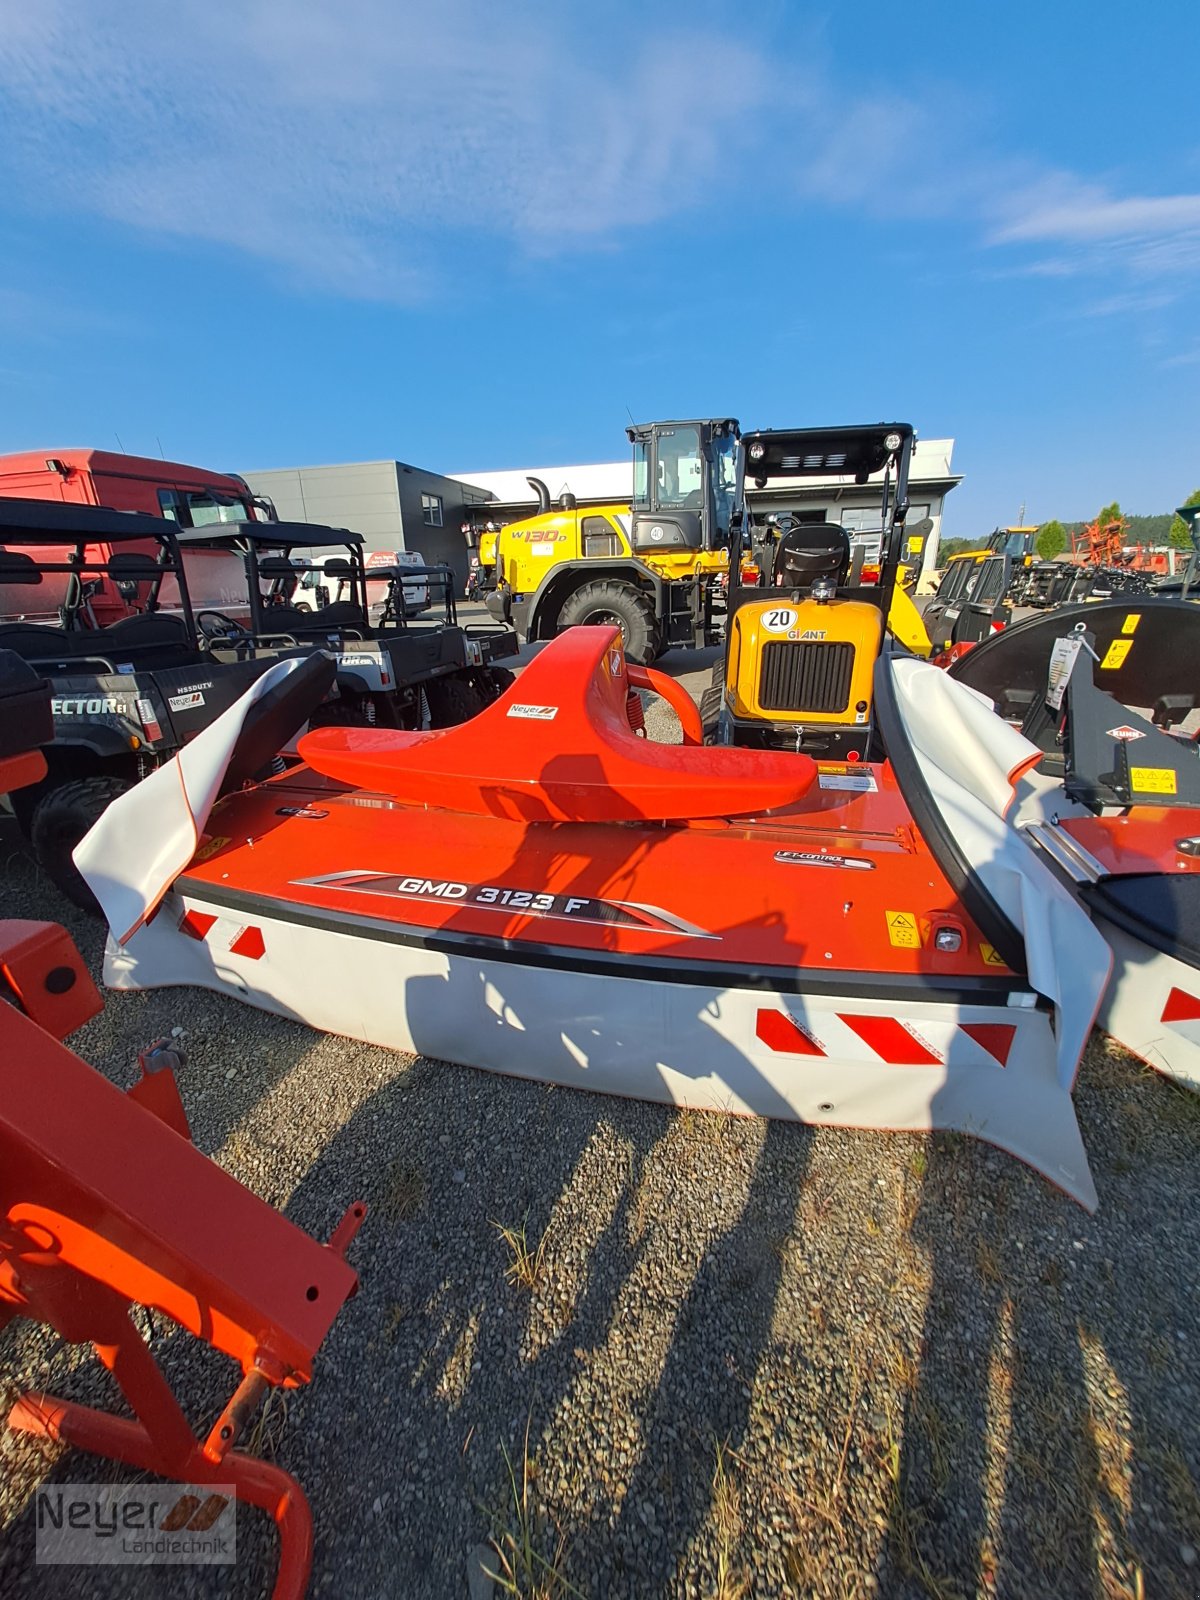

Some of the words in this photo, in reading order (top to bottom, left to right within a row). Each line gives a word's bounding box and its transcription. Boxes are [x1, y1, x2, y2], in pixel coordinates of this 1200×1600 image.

[652, 528, 662, 539] 40
[768, 610, 790, 626] 20
[51, 699, 117, 715] ECTOR
[511, 705, 539, 714] Neyer
[1112, 730, 1138, 738] KUHN
[777, 850, 844, 862] LIFT-CONTROL
[398, 878, 468, 898] GMD
[476, 887, 555, 911] 3123
[564, 898, 589, 913] F
